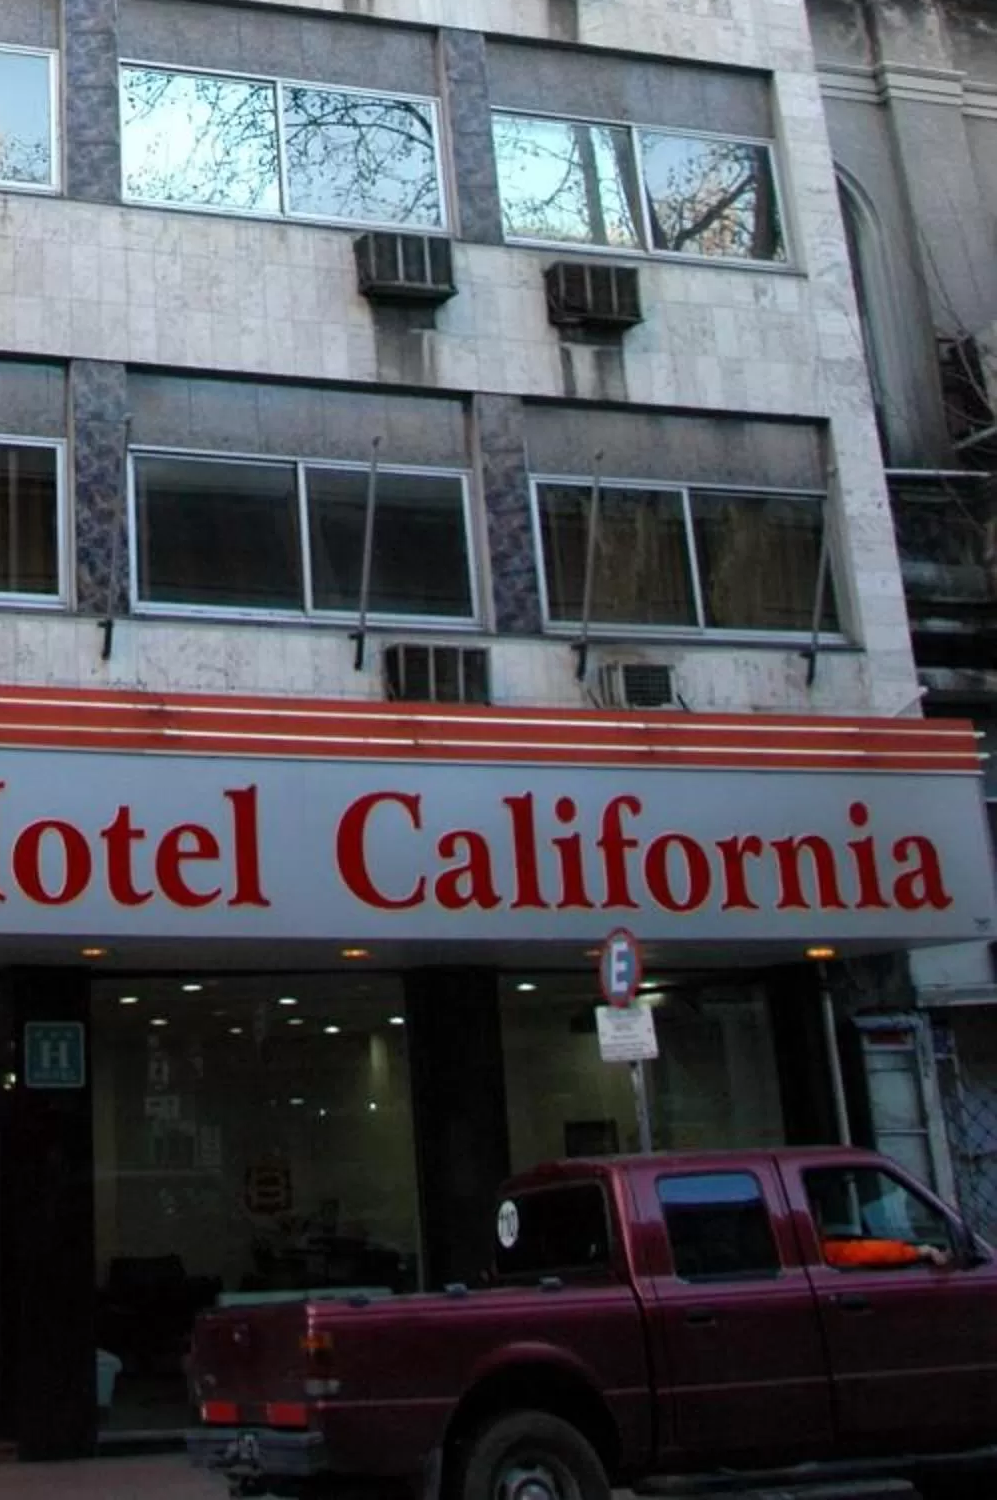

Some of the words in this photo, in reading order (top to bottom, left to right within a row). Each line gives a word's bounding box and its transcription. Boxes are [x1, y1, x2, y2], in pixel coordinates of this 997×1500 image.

[335, 789, 953, 913] California
[611, 941, 629, 992] E
[39, 1039, 71, 1069] H
